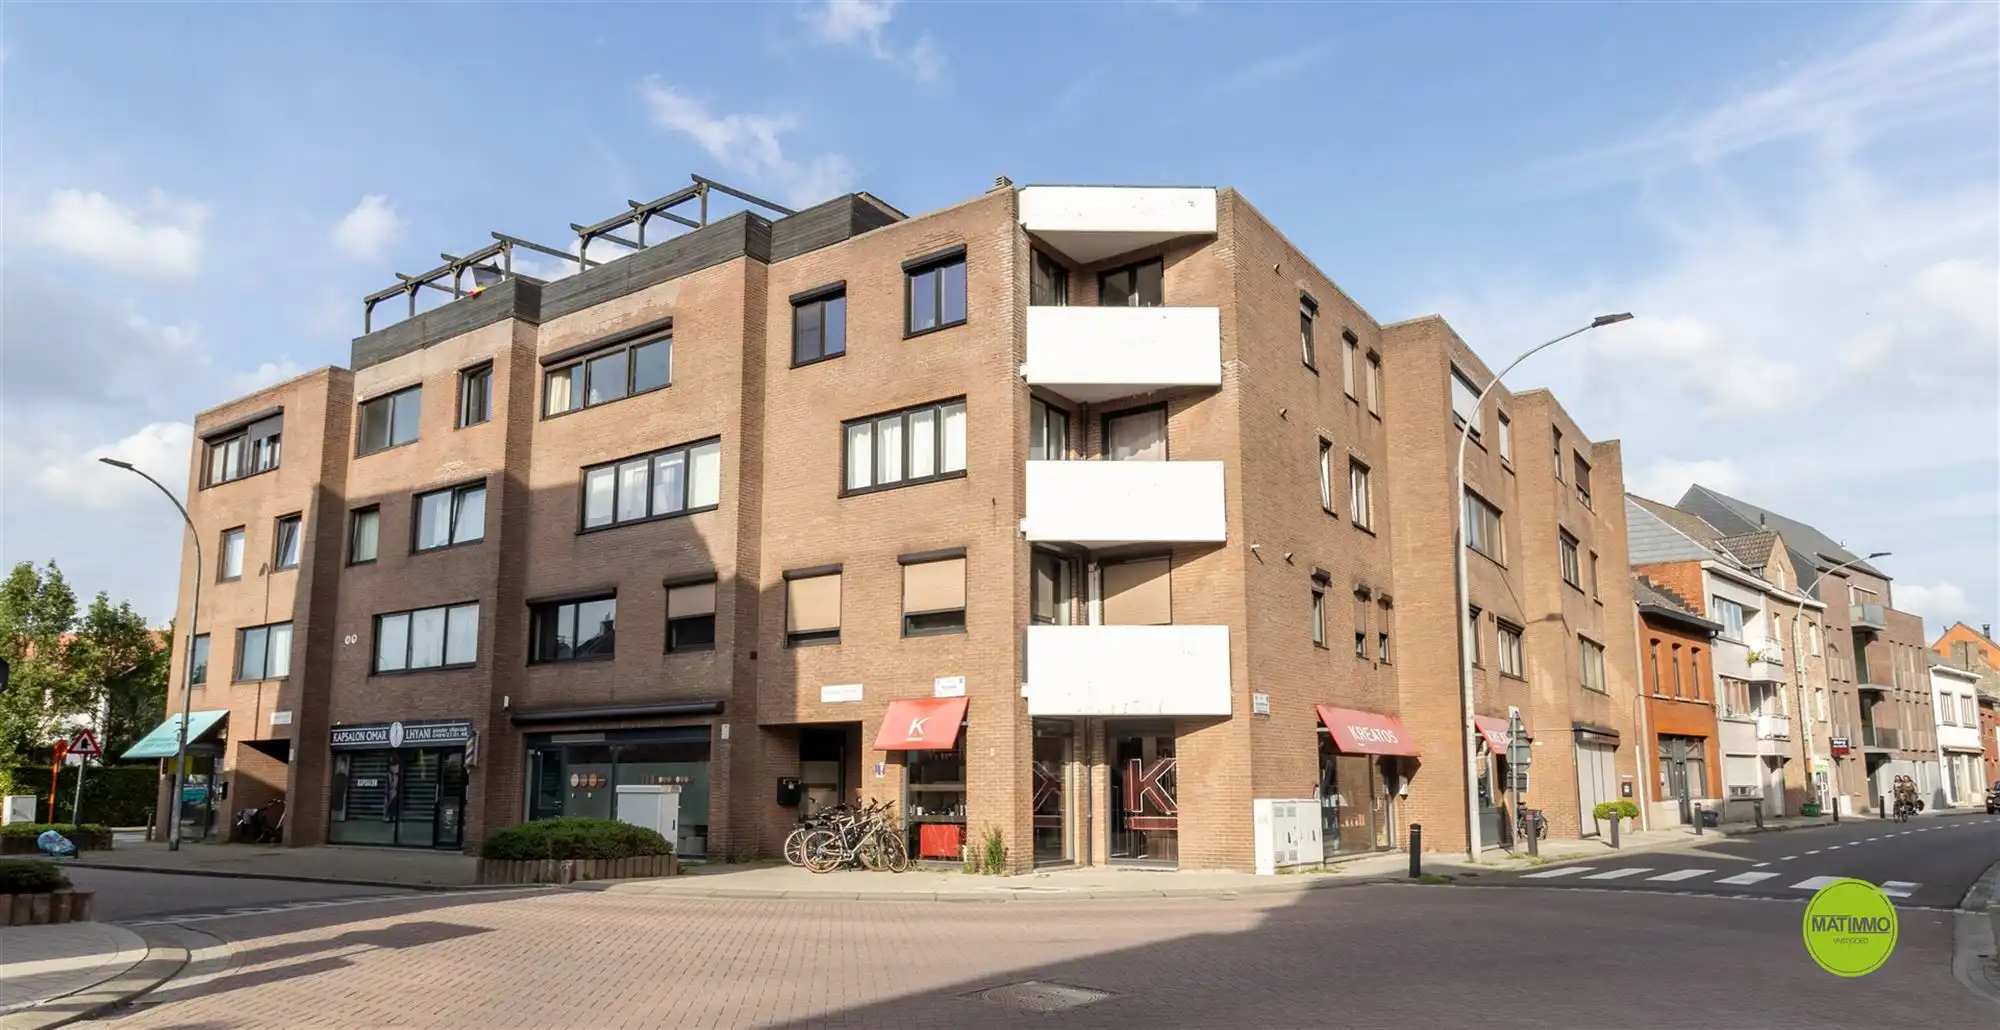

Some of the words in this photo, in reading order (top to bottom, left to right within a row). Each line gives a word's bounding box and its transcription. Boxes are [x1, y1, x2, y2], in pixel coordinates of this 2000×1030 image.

[333, 731, 366, 742] KAPSALON
[366, 730, 387, 741] OMAR
[406, 728, 431, 739] LHYANI
[908, 717, 930, 735] K
[1347, 724, 1398, 744] KREATOS
[1130, 758, 1177, 813] K
